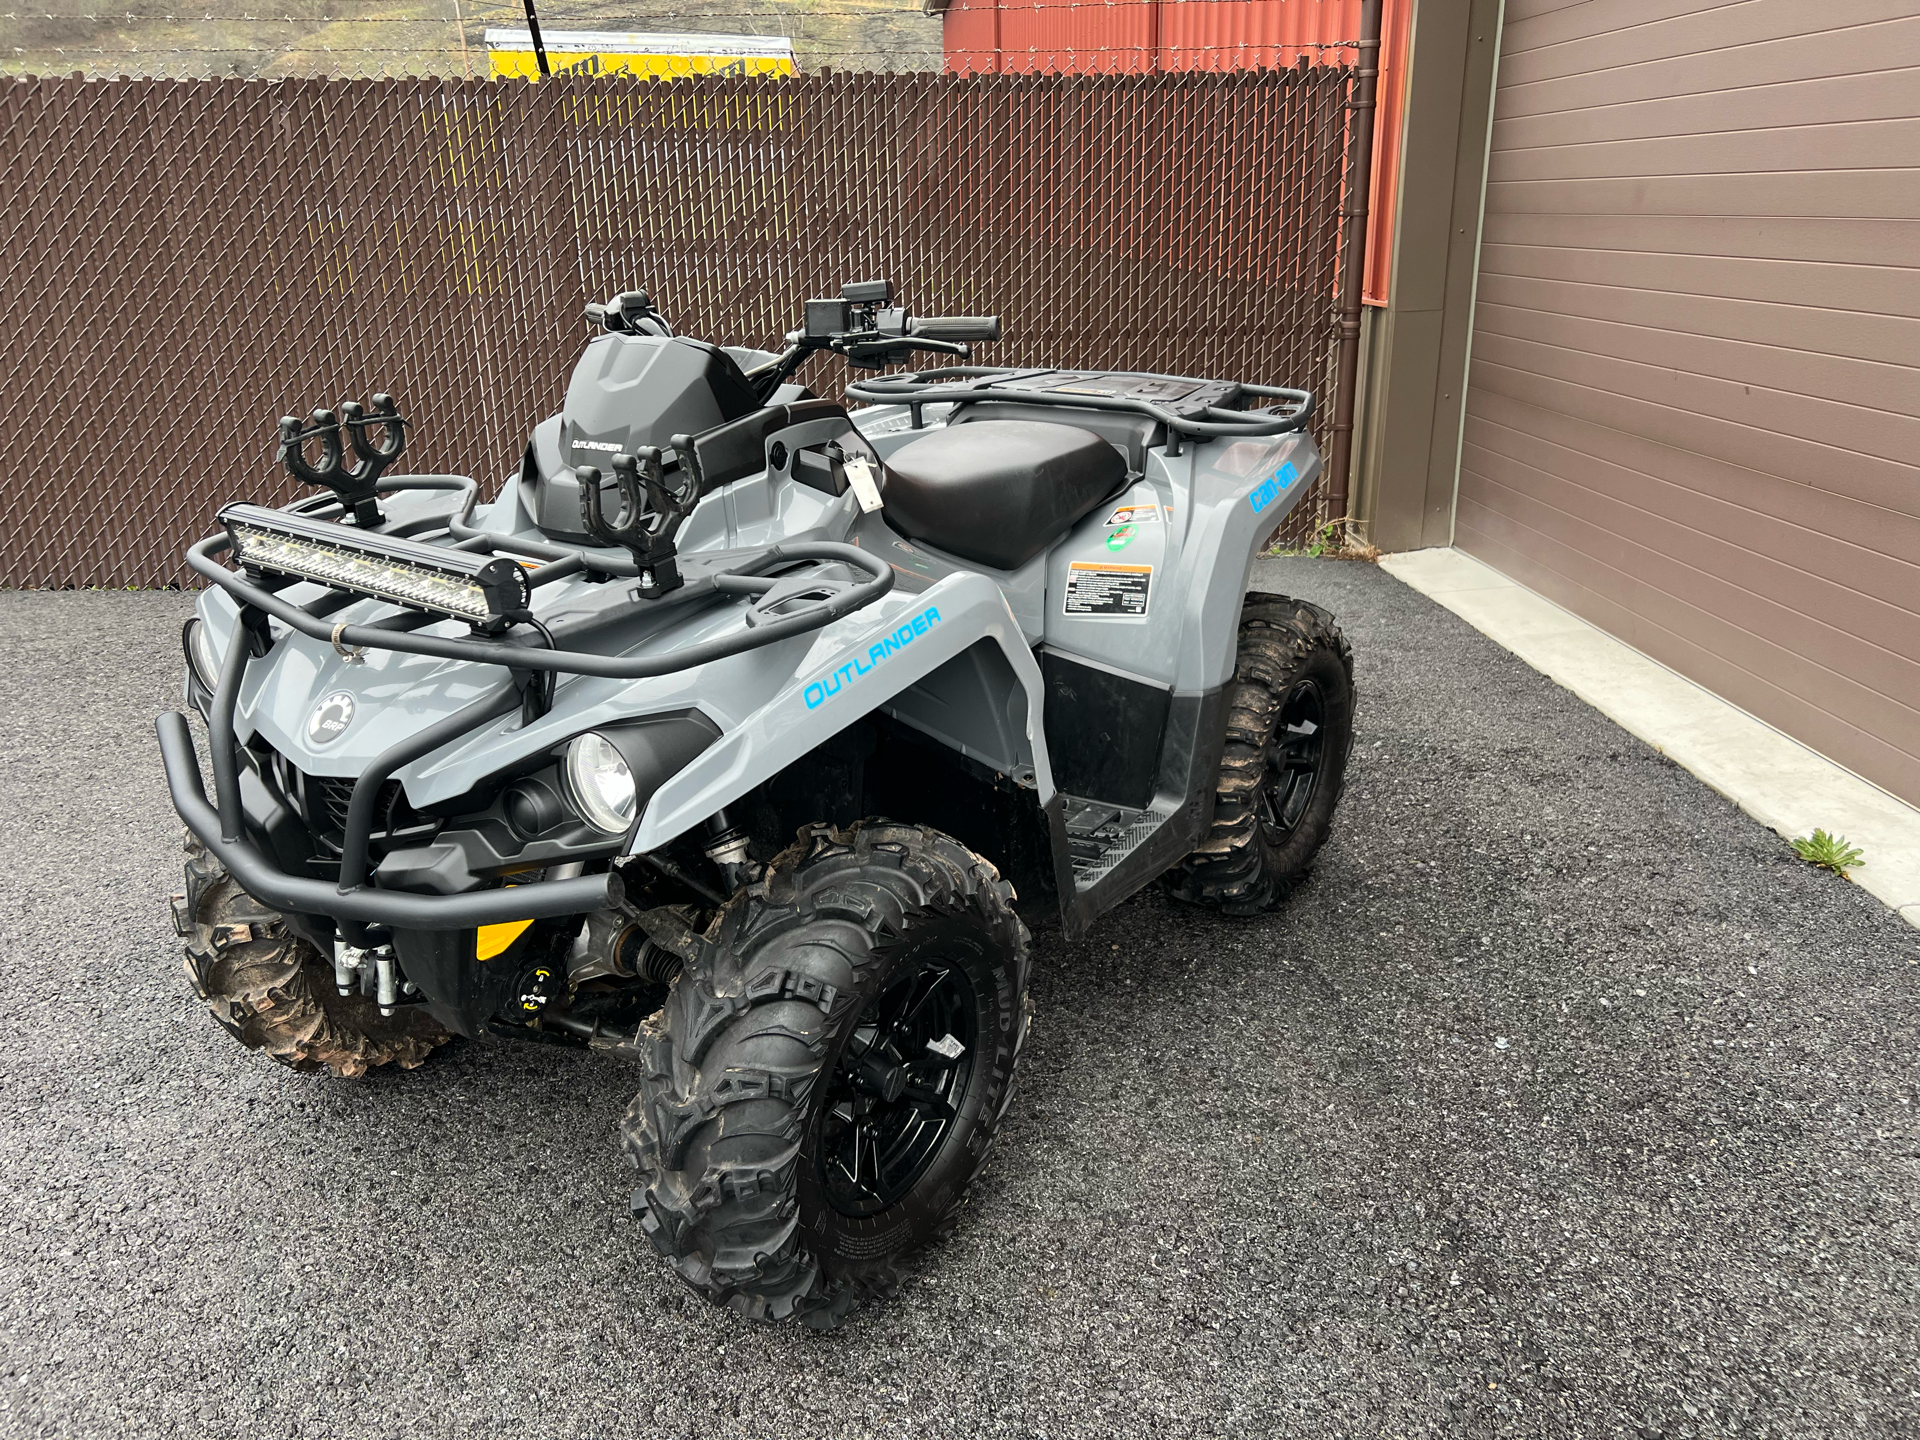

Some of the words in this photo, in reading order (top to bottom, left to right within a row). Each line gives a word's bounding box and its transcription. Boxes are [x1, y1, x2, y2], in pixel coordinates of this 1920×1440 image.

[571, 440, 623, 452] OUTLANDER
[803, 606, 942, 710] OUTLANDER
[321, 719, 346, 731] BRP
[991, 965, 1012, 1032] MUD
[978, 1044, 1008, 1127] LITE
